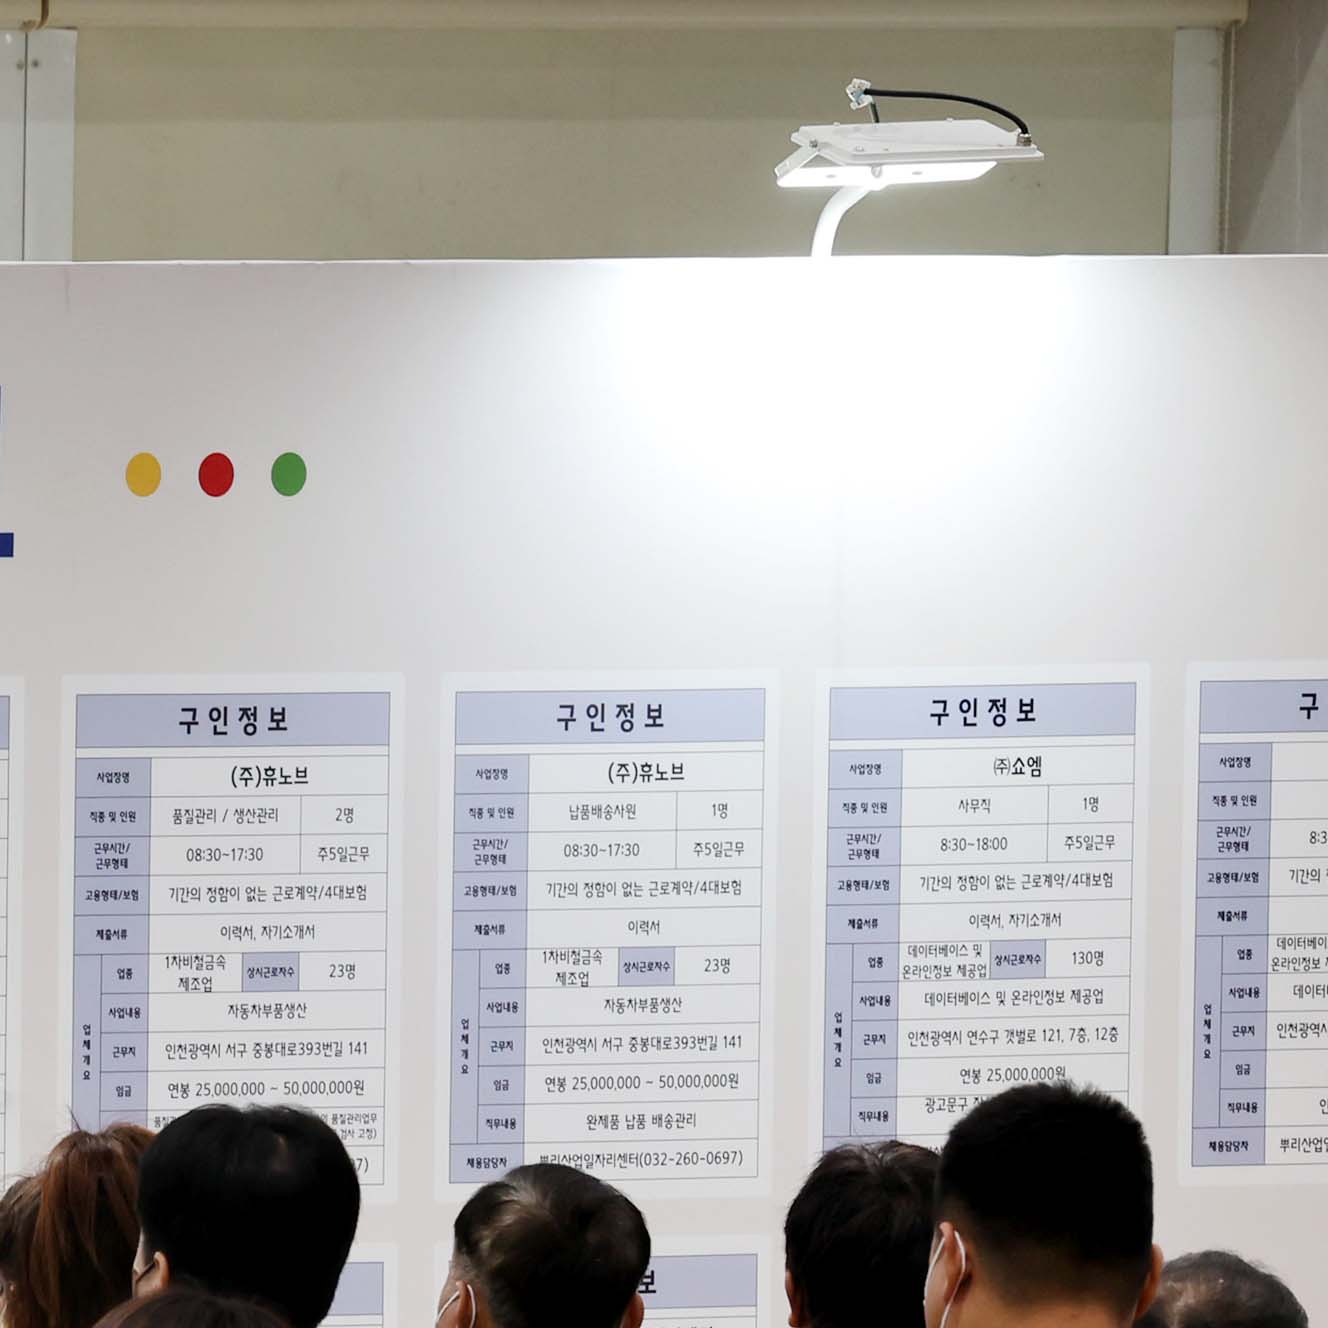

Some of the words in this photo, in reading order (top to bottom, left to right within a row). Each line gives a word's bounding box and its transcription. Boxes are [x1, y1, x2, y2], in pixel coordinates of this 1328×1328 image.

[231, 765, 309, 789] (주)휴노브
[608, 761, 685, 785] (주)휴노브
[568, 803, 637, 821] 납품배송사원
[712, 802, 728, 820] 1명
[958, 798, 991, 814] 사무직
[1083, 796, 1099, 813] 1명
[172, 808, 217, 825] 품질관리
[233, 807, 279, 825] 생산관리
[335, 807, 354, 824] 2명
[940, 836, 1008, 852] 8:30~18:00
[1063, 834, 1116, 852] 주5일근무
[185, 847, 264, 863] 08:30~17:30
[968, 913, 1005, 930] 이력서,
[1008, 912, 1062, 929] 자기소개서
[220, 924, 257, 942] 이력서,
[260, 924, 315, 940] 자기소개서
[1072, 950, 1104, 967] 130명
[329, 963, 356, 981] 23명
[924, 991, 991, 1007] 데이터베이스
[995, 990, 1006, 1007] 및
[1010, 989, 1065, 1007] 온라인정보
[1070, 988, 1104, 1006] 제공업
[227, 1002, 308, 1021] 자동차부품생산
[542, 1037, 597, 1055] 인천광역시
[601, 1036, 623, 1053] 서구
[628, 1035, 718, 1054] 중봉대로393번길
[723, 1034, 742, 1049] 141
[907, 1029, 962, 1048] 인천광역시
[966, 1029, 999, 1046] 연수구
[1003, 1028, 1037, 1045] 갯벌로
[1042, 1028, 1065, 1044] 121,
[1068, 1026, 1090, 1044] 7층,
[1095, 1025, 1119, 1043] 12층
[959, 1068, 981, 1085] 연봉
[586, 1113, 620, 1131] 완제품
[625, 1113, 647, 1131] 납품
[651, 1112, 697, 1130] 배송관리
